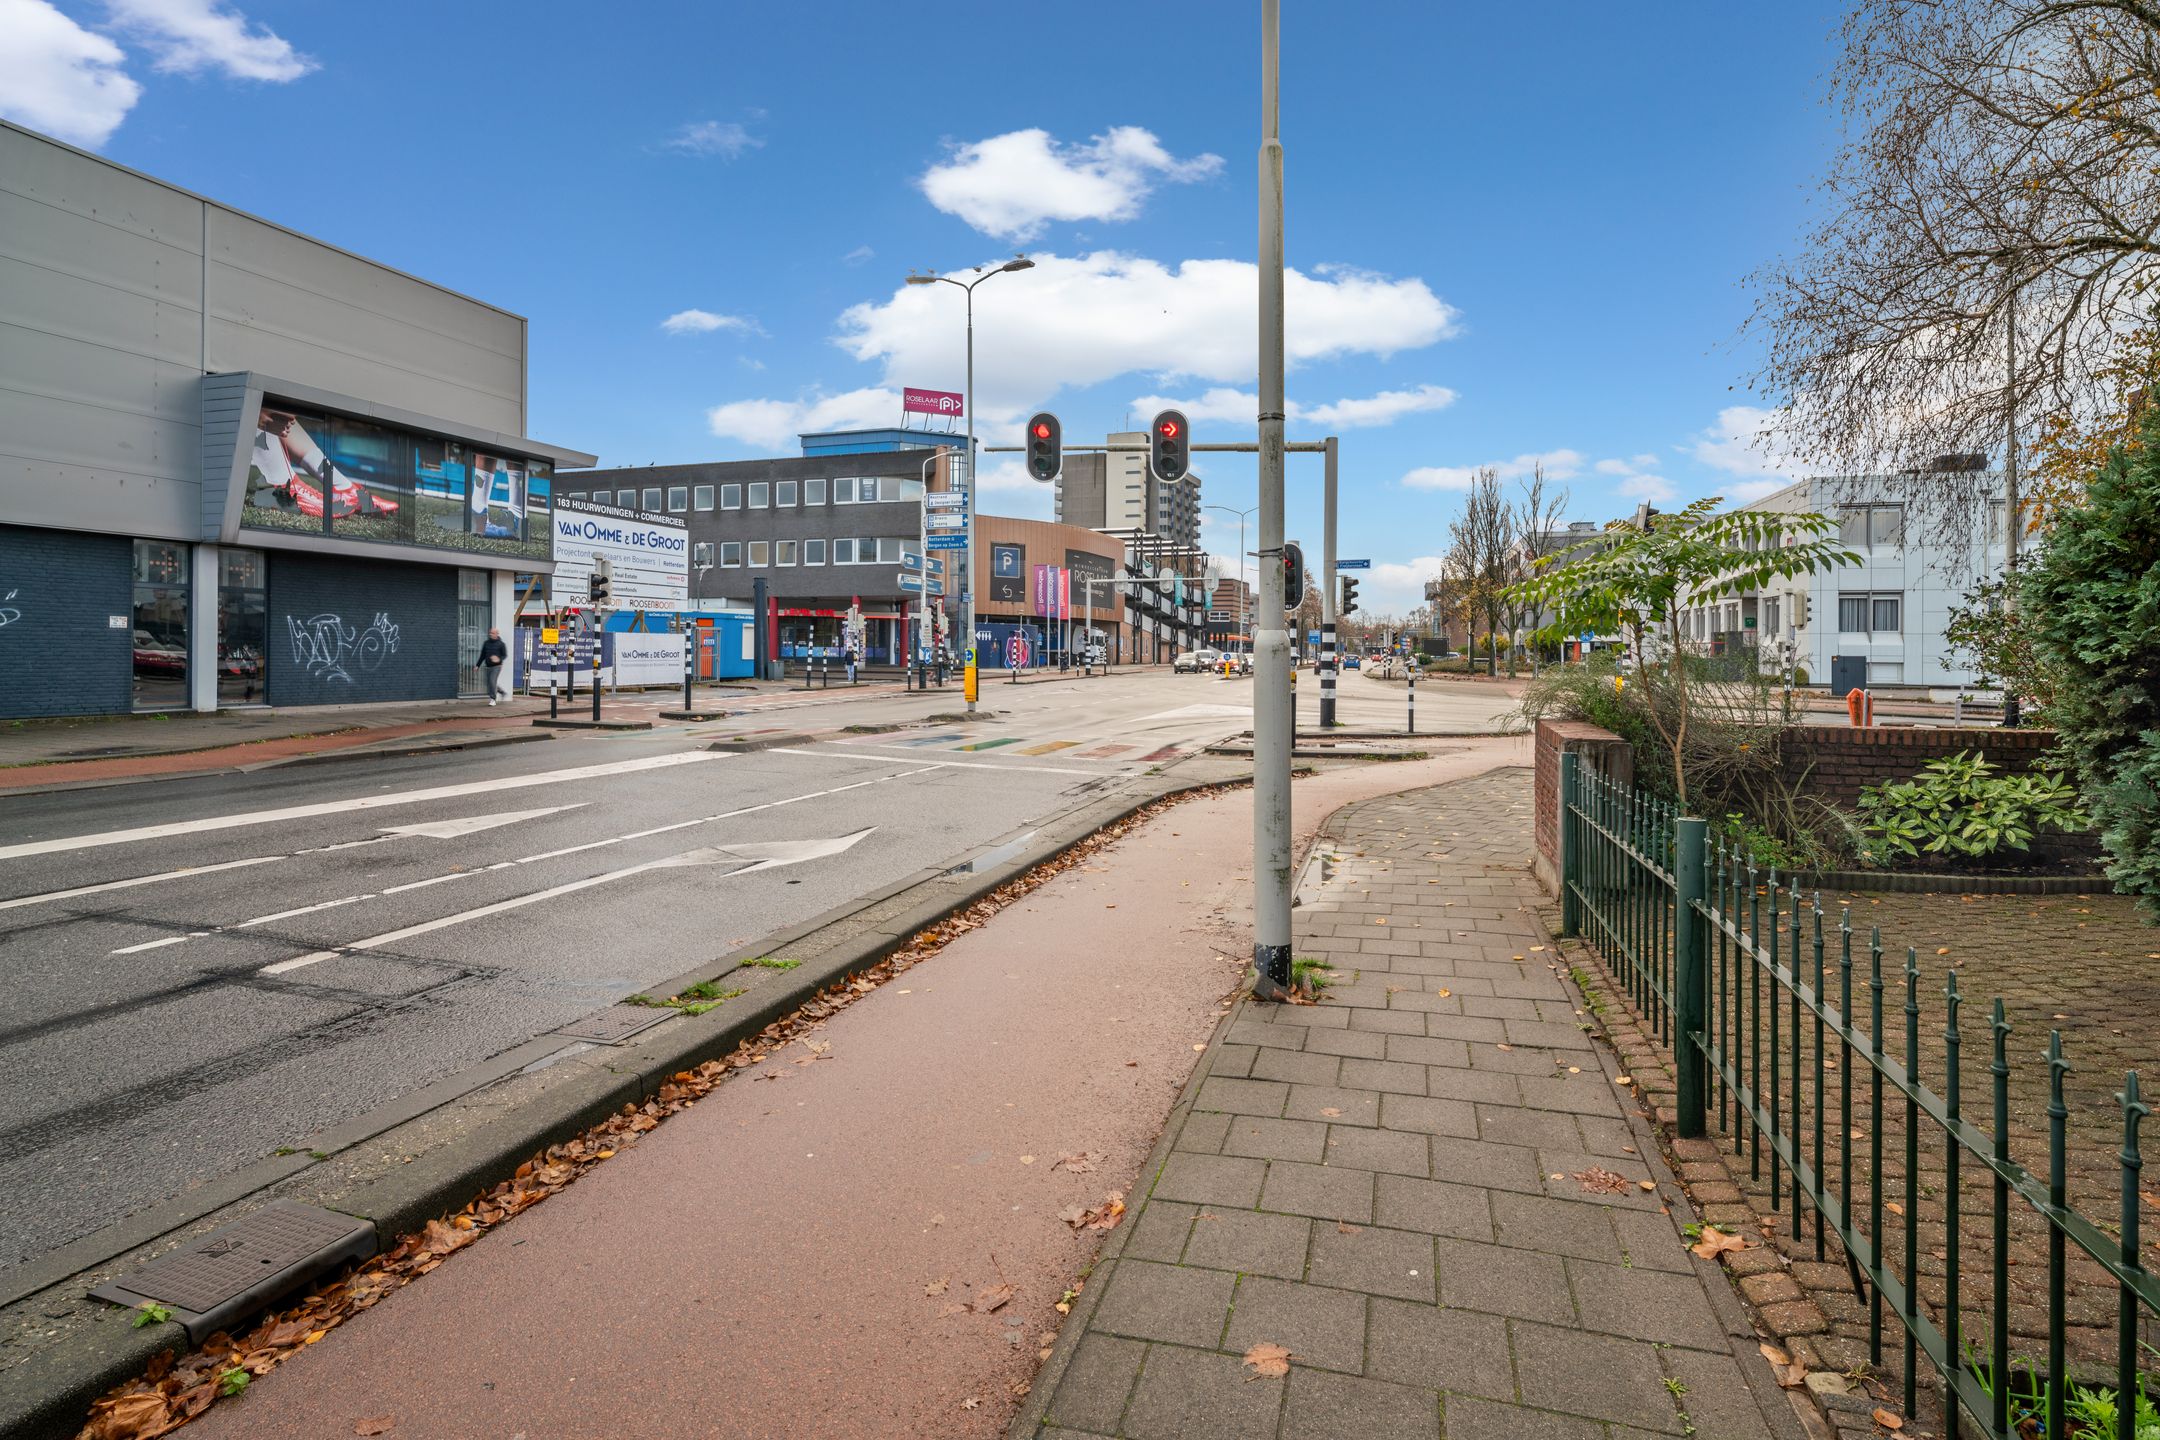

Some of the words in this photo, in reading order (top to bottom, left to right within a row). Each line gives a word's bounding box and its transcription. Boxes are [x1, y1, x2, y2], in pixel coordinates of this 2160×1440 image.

[905, 395, 938, 404] ROSELAAR
[557, 497, 570, 508] 163
[572, 500, 634, 518] HUURWONINGEN
[640, 512, 686, 527] COMMERCIEEL
[558, 520, 582, 537] VAN
[584, 521, 621, 542] OMME
[632, 532, 645, 546] DE
[647, 531, 685, 551] GROOT
[632, 555, 656, 566] Bouwers
[663, 560, 685, 569] Rotterdam
[632, 650, 649, 659] OMME
[660, 650, 680, 659] GROOT
